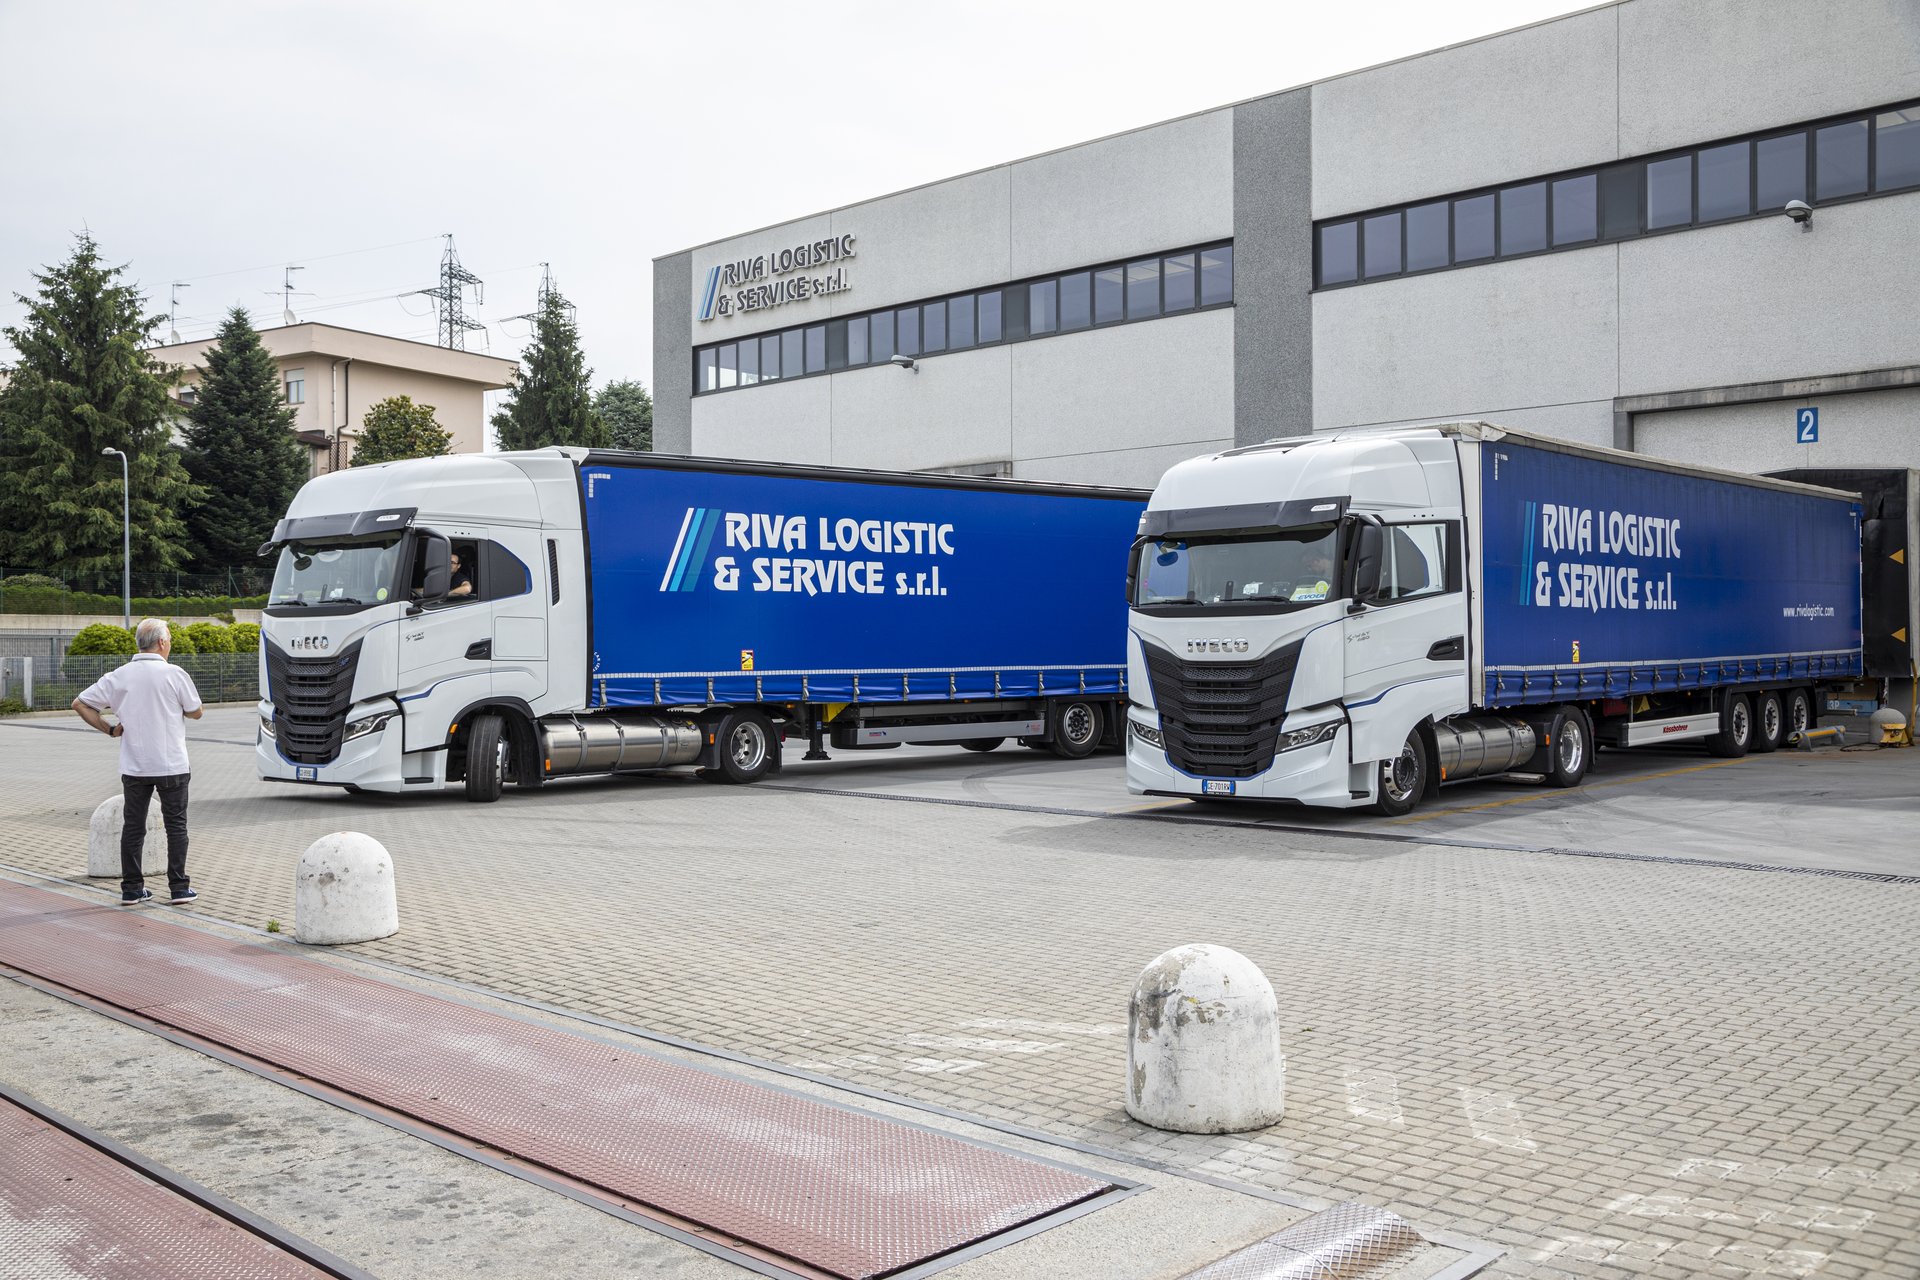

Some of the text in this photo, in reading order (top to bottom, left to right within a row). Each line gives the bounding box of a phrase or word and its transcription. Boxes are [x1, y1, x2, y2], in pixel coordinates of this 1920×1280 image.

[724, 234, 855, 287] RIVA LOGISTIC
[717, 267, 850, 316] & SERVICE s.r.l.
[1801, 410, 1814, 441] 2
[725, 512, 955, 556] RIVA LOGISTIC
[1542, 503, 1681, 559] RIVA LOGISTIC
[713, 556, 947, 597] & SERVICE s.r.l.
[1535, 561, 1677, 614] & SERVICE s.r.l.
[1783, 603, 1835, 621] www.rivalogistic.com
[291, 636, 329, 650] IVECO
[1187, 637, 1249, 653] IVECO
